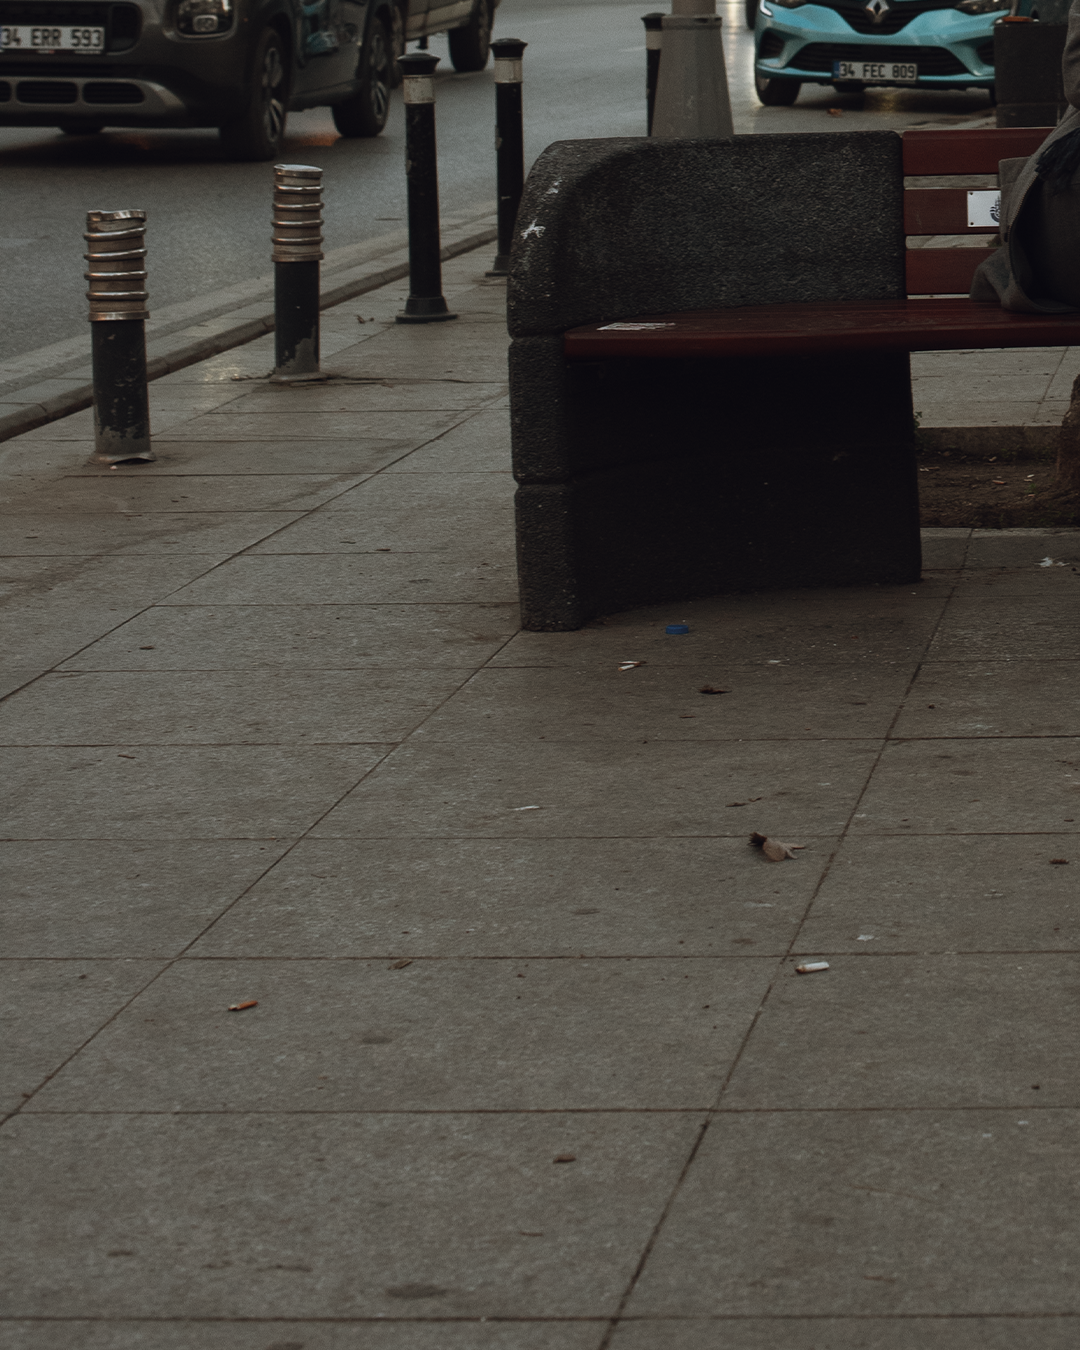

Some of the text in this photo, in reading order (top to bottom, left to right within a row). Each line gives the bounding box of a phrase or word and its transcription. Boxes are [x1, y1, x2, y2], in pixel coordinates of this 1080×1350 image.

[1, 28, 101, 47] 34 ERR 593
[840, 63, 916, 79] 34 FEC 809
